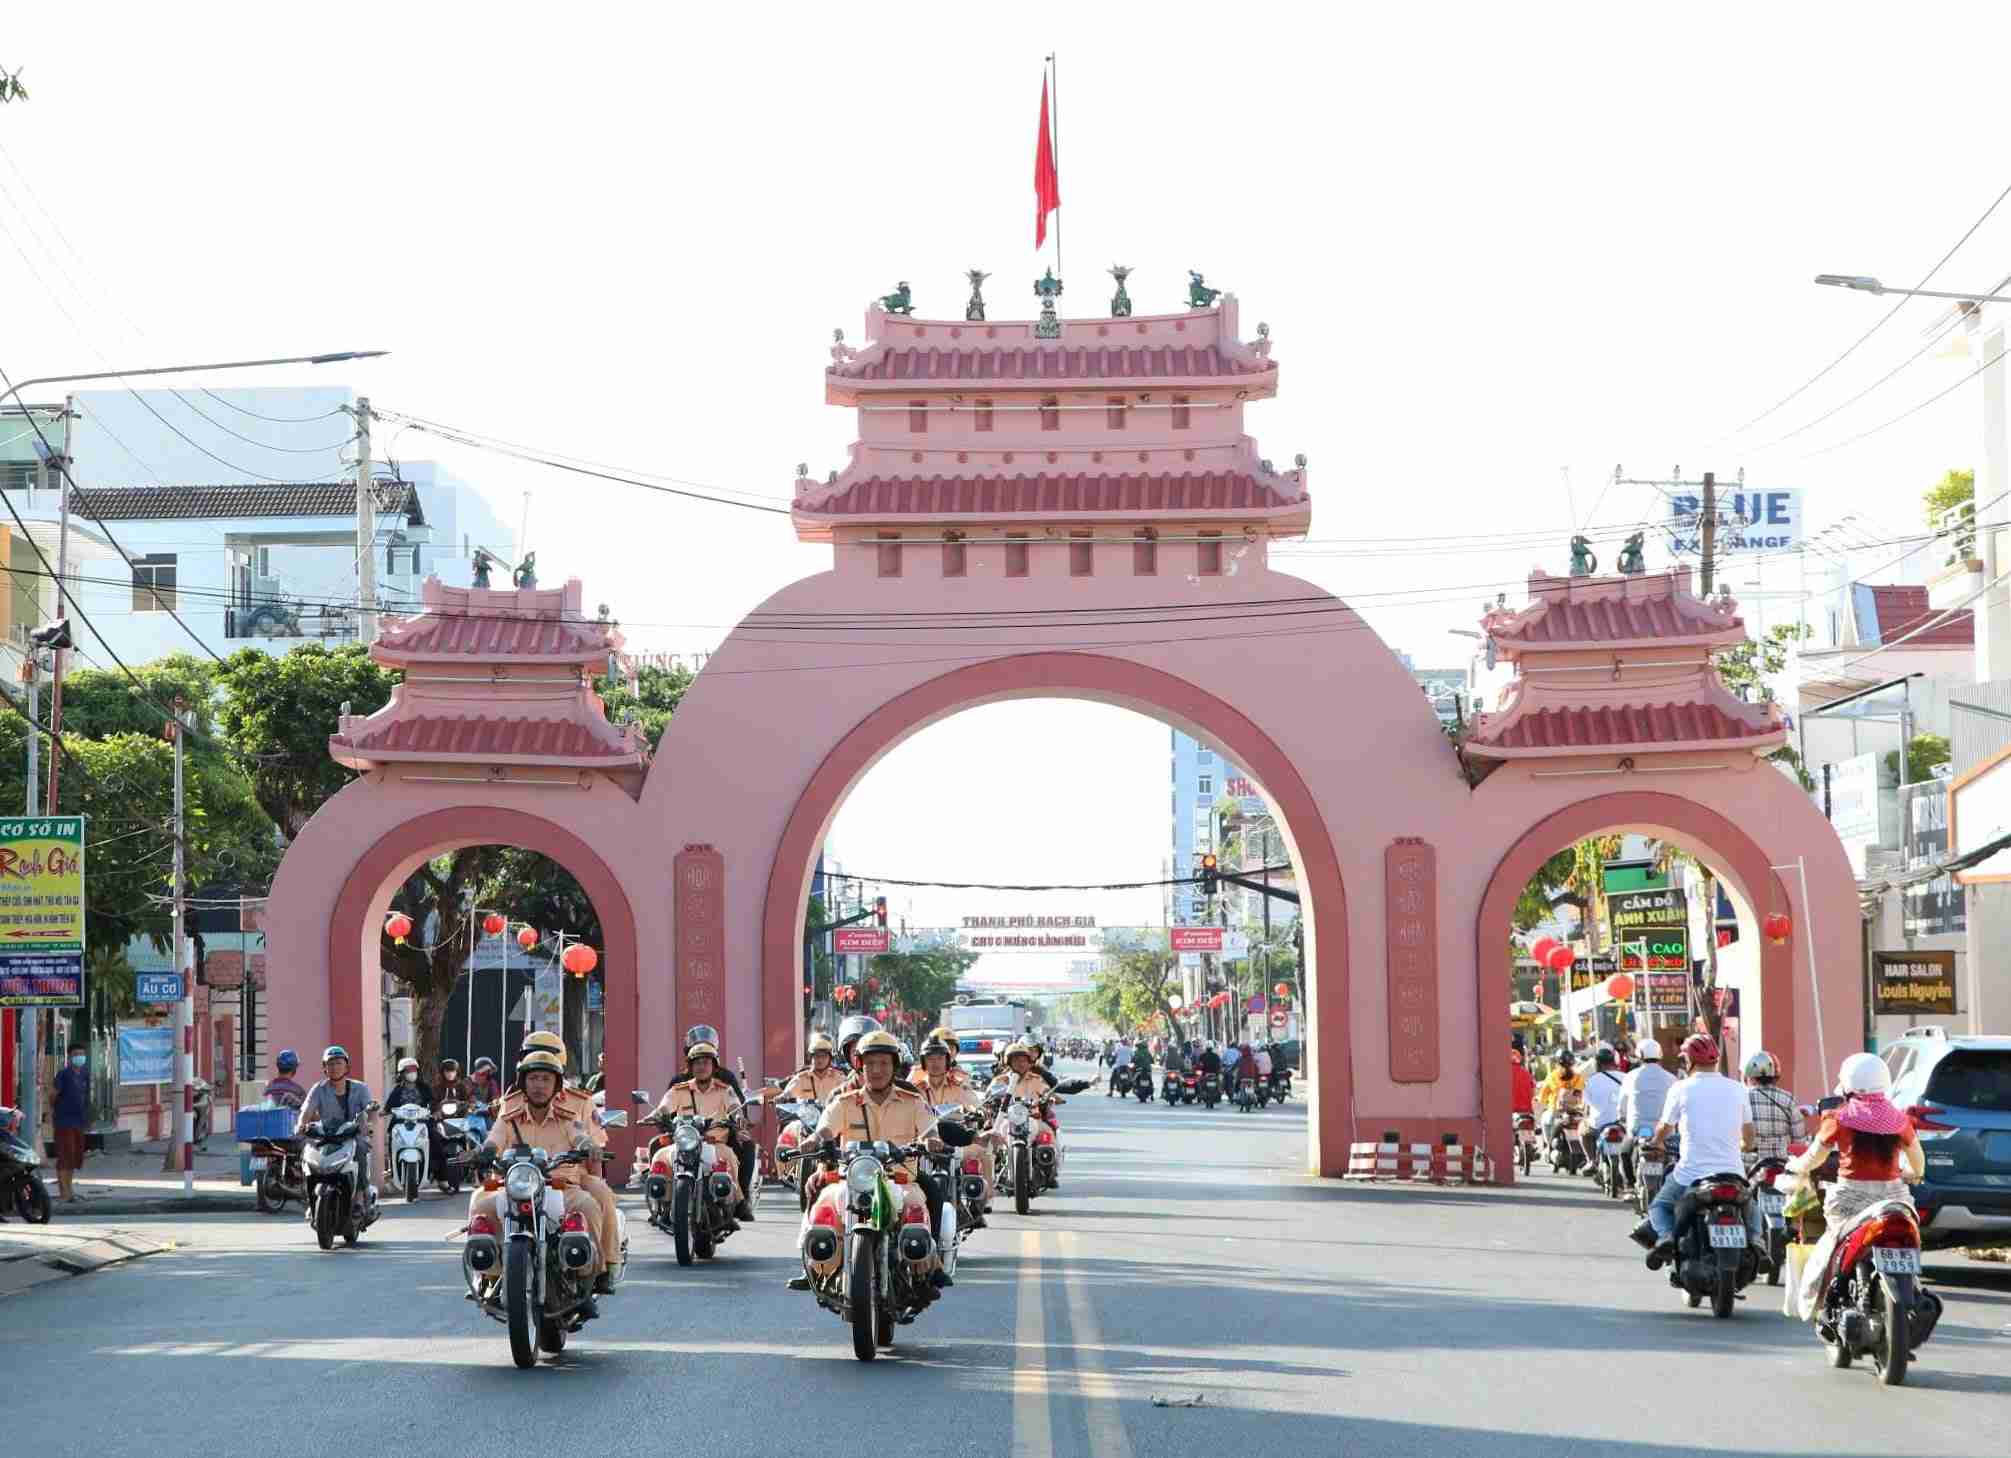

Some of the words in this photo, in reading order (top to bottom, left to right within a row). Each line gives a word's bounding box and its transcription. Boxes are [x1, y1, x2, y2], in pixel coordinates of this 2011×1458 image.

[1672, 493, 1791, 528] BUE
[1652, 943, 1683, 954] CAO
[1884, 963, 1908, 977] HAIR
[1910, 963, 1943, 977] SALON
[1877, 983, 1908, 999] Louis
